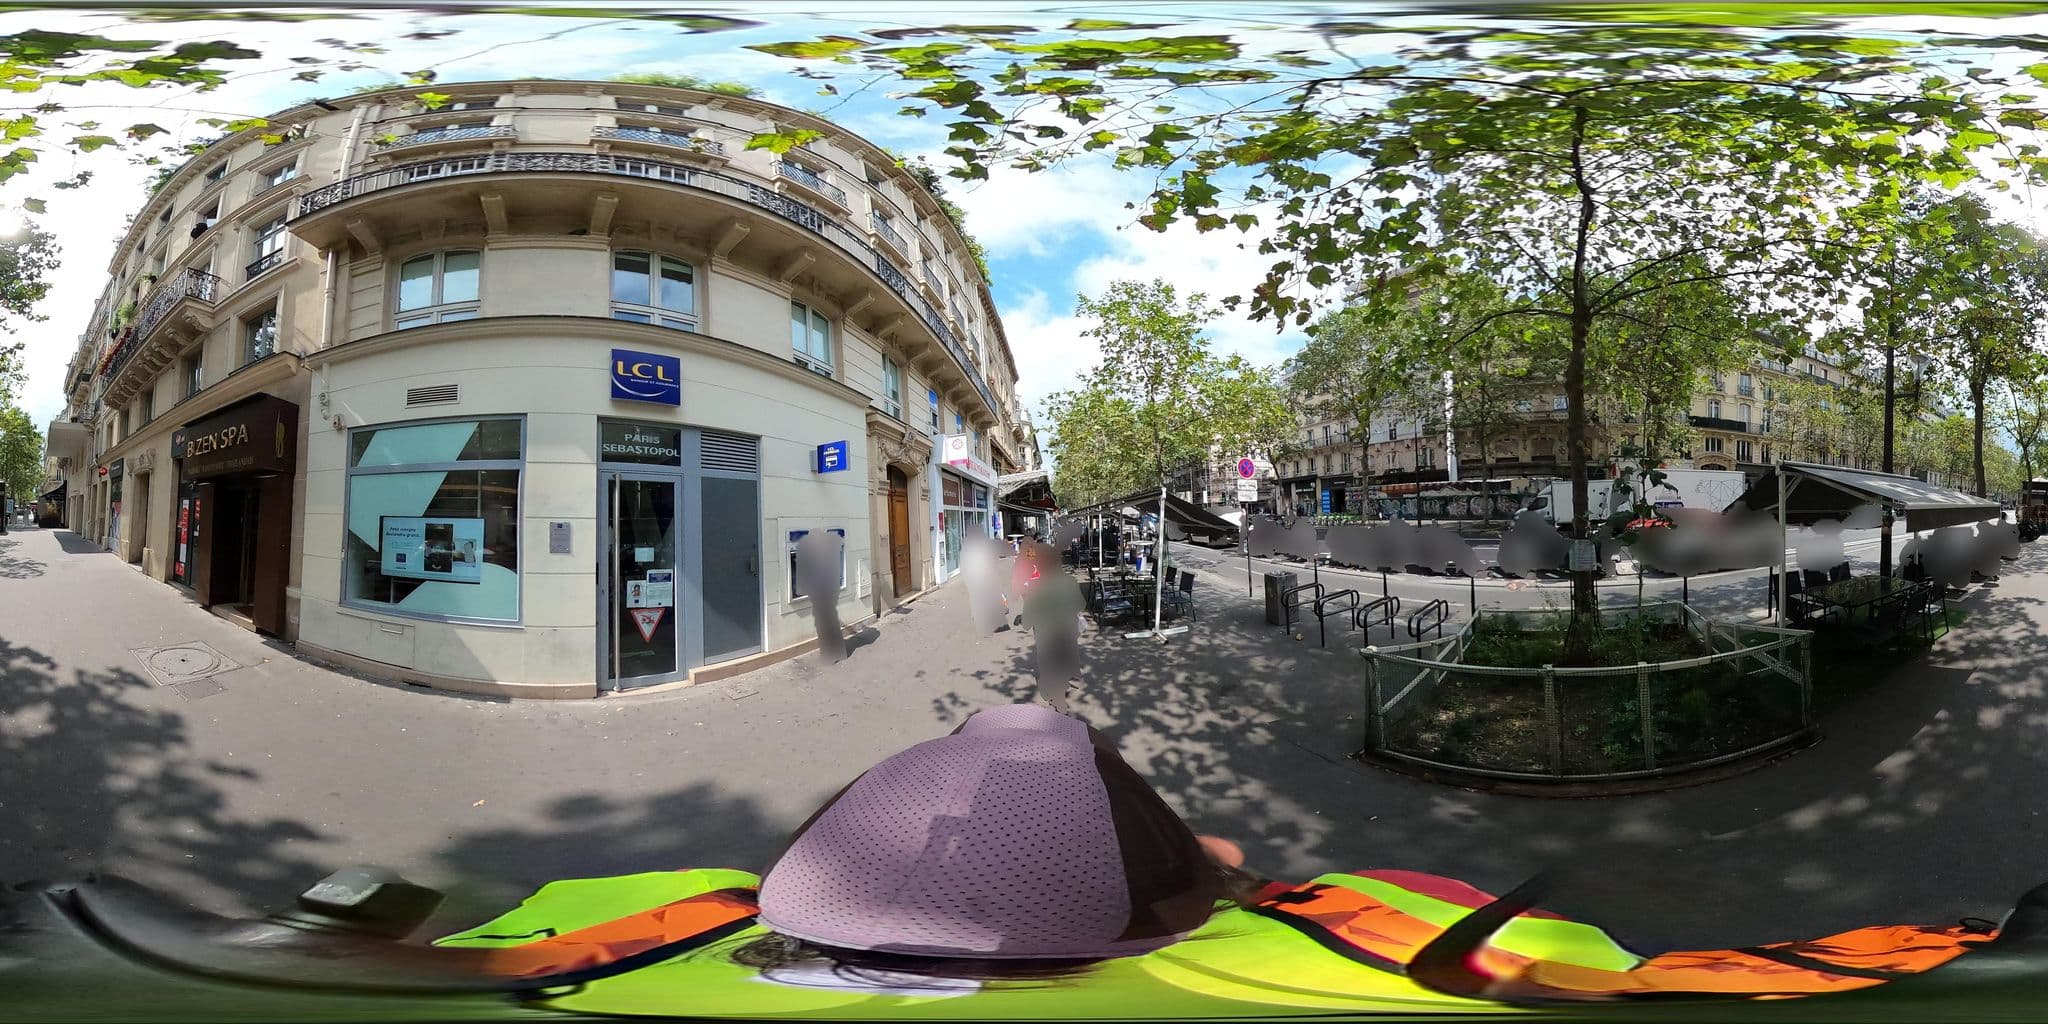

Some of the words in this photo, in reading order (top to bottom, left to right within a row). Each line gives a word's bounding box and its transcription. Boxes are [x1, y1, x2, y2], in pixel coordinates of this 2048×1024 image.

[617, 361, 673, 382] LCL
[220, 424, 249, 448] SPA
[624, 433, 660, 444] PARIS
[603, 443, 680, 457] SEBASTOPOL
